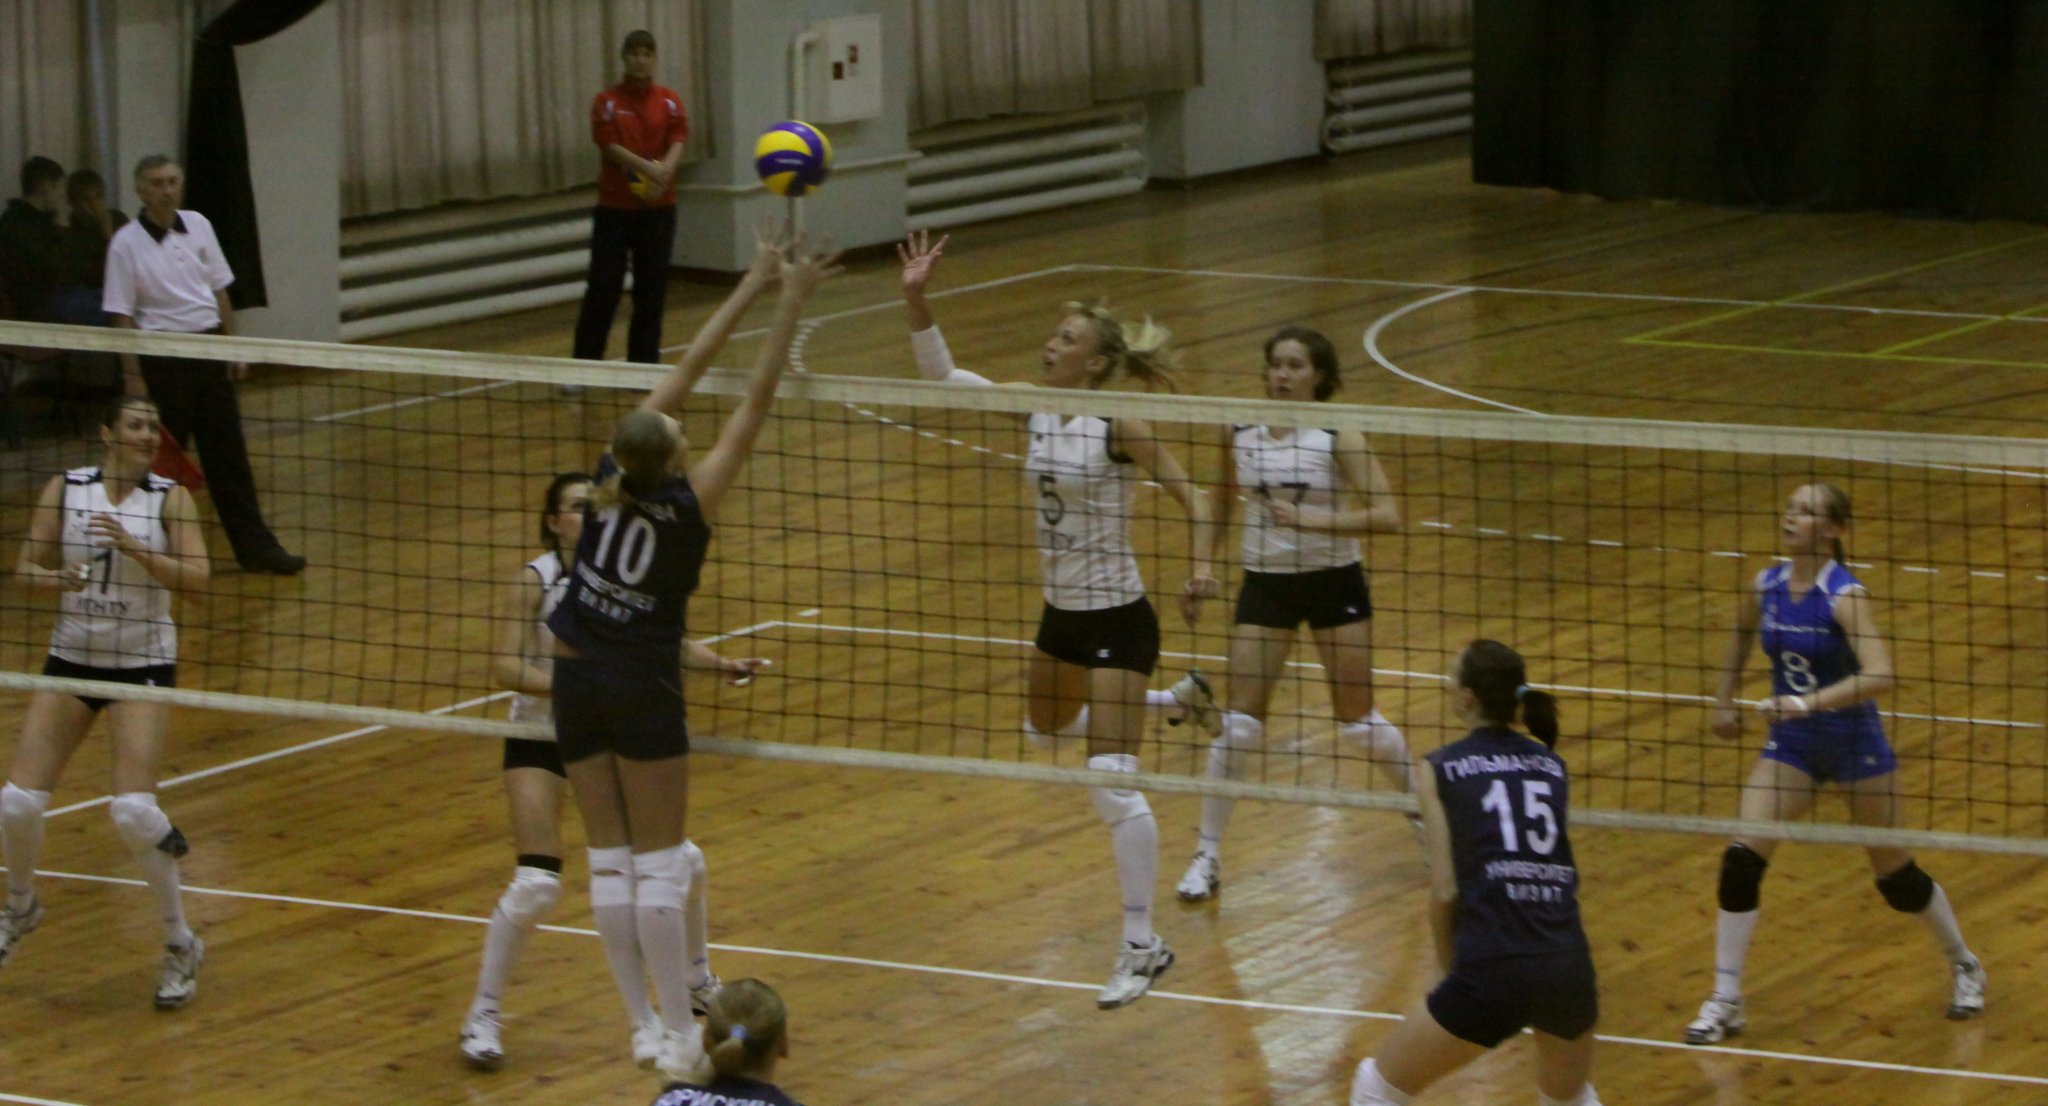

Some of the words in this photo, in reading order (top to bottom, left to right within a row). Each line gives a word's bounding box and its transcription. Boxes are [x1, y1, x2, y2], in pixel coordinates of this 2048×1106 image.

[1038, 474, 1066, 526] 5
[593, 503, 657, 586] 10
[1780, 650, 1819, 694] 8
[1481, 778, 1559, 856] 15
